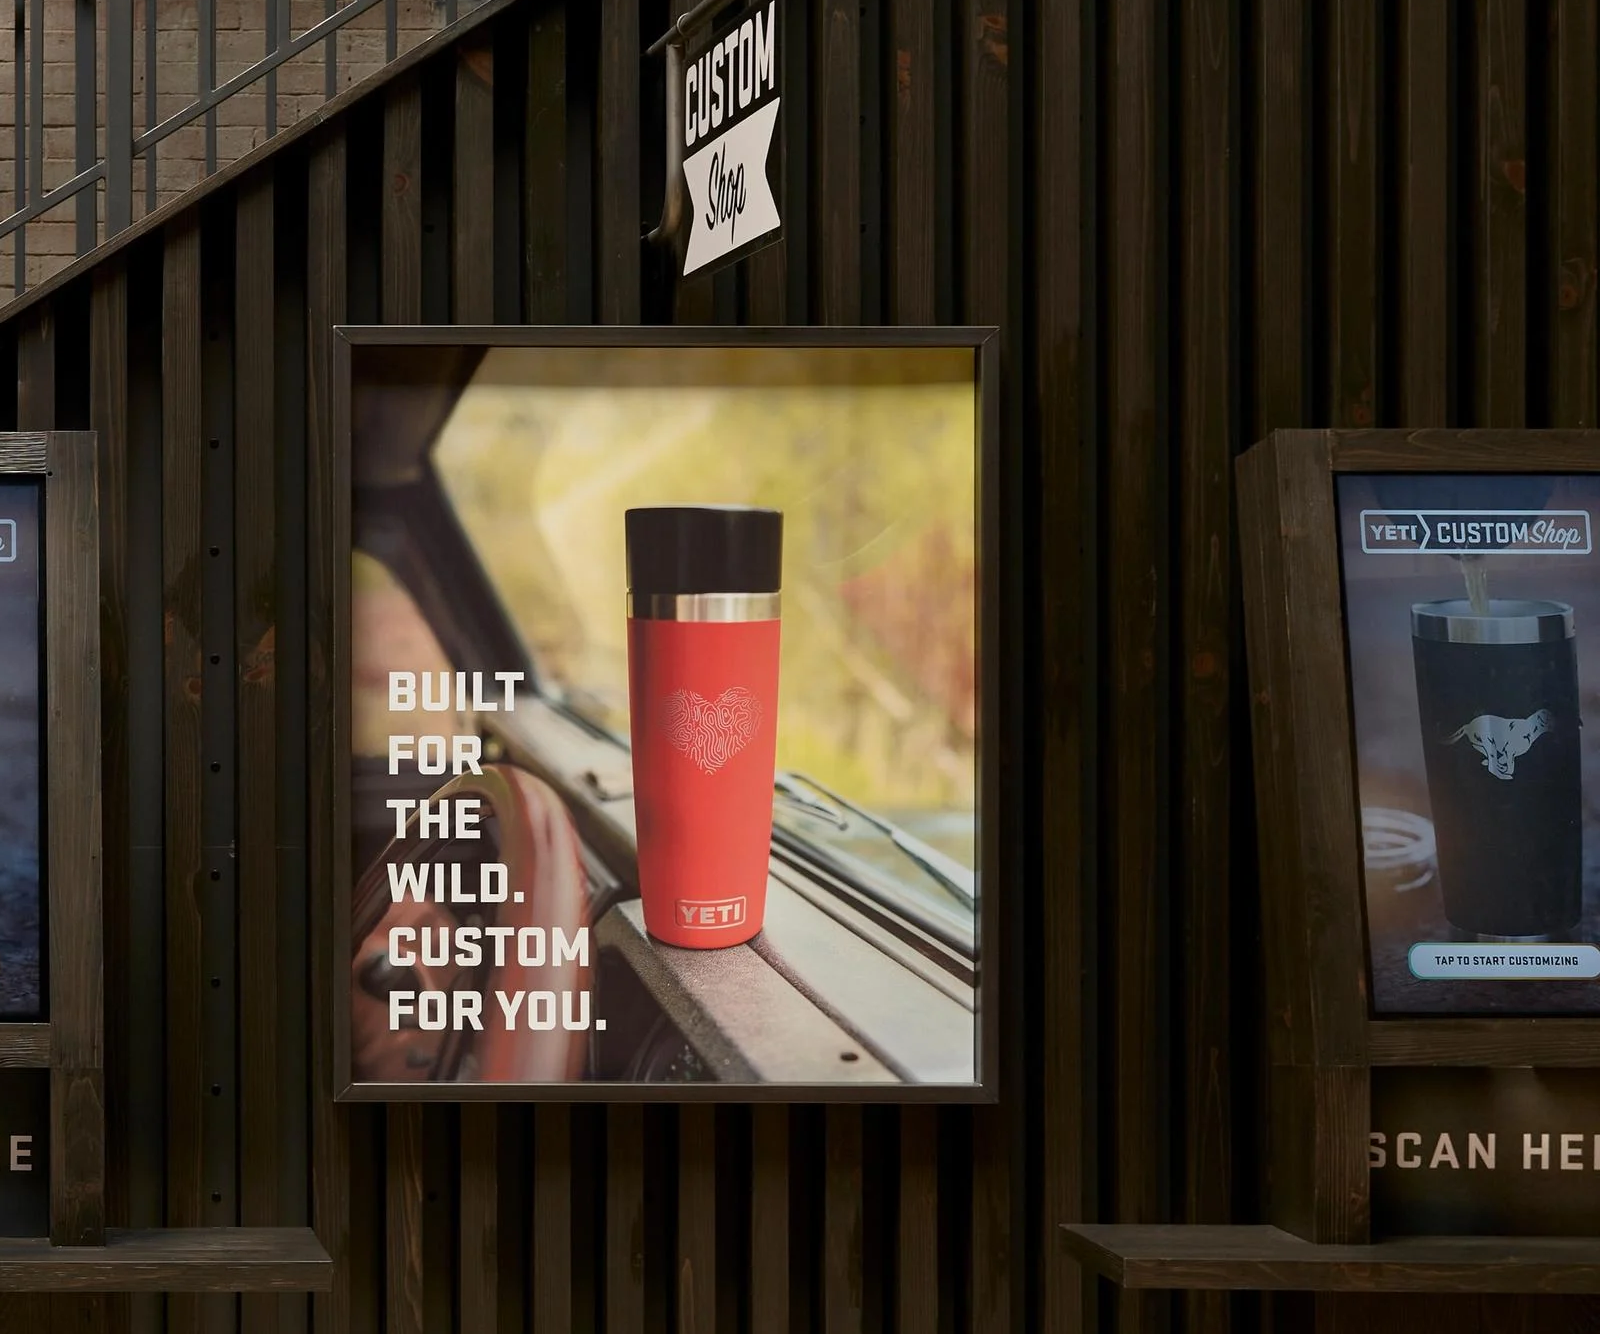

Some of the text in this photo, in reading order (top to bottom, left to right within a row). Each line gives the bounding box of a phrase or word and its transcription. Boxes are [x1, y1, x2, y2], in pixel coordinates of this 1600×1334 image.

[685, 0, 775, 148] CUSTOM
[706, 141, 746, 245] Shop
[1370, 519, 1581, 551] YETI CUSTOM Shop
[387, 671, 525, 711] BUILT
[387, 735, 483, 775] FOR
[386, 799, 481, 839] THE
[387, 863, 525, 903] WILD.
[678, 903, 741, 925] YETI
[387, 927, 590, 967] CUSTOM
[1435, 955, 1579, 966] TAP TO START CUSTOMIZING
[387, 990, 607, 1030] FOR YOU.
[1369, 1132, 1600, 1170] SCAN HE
